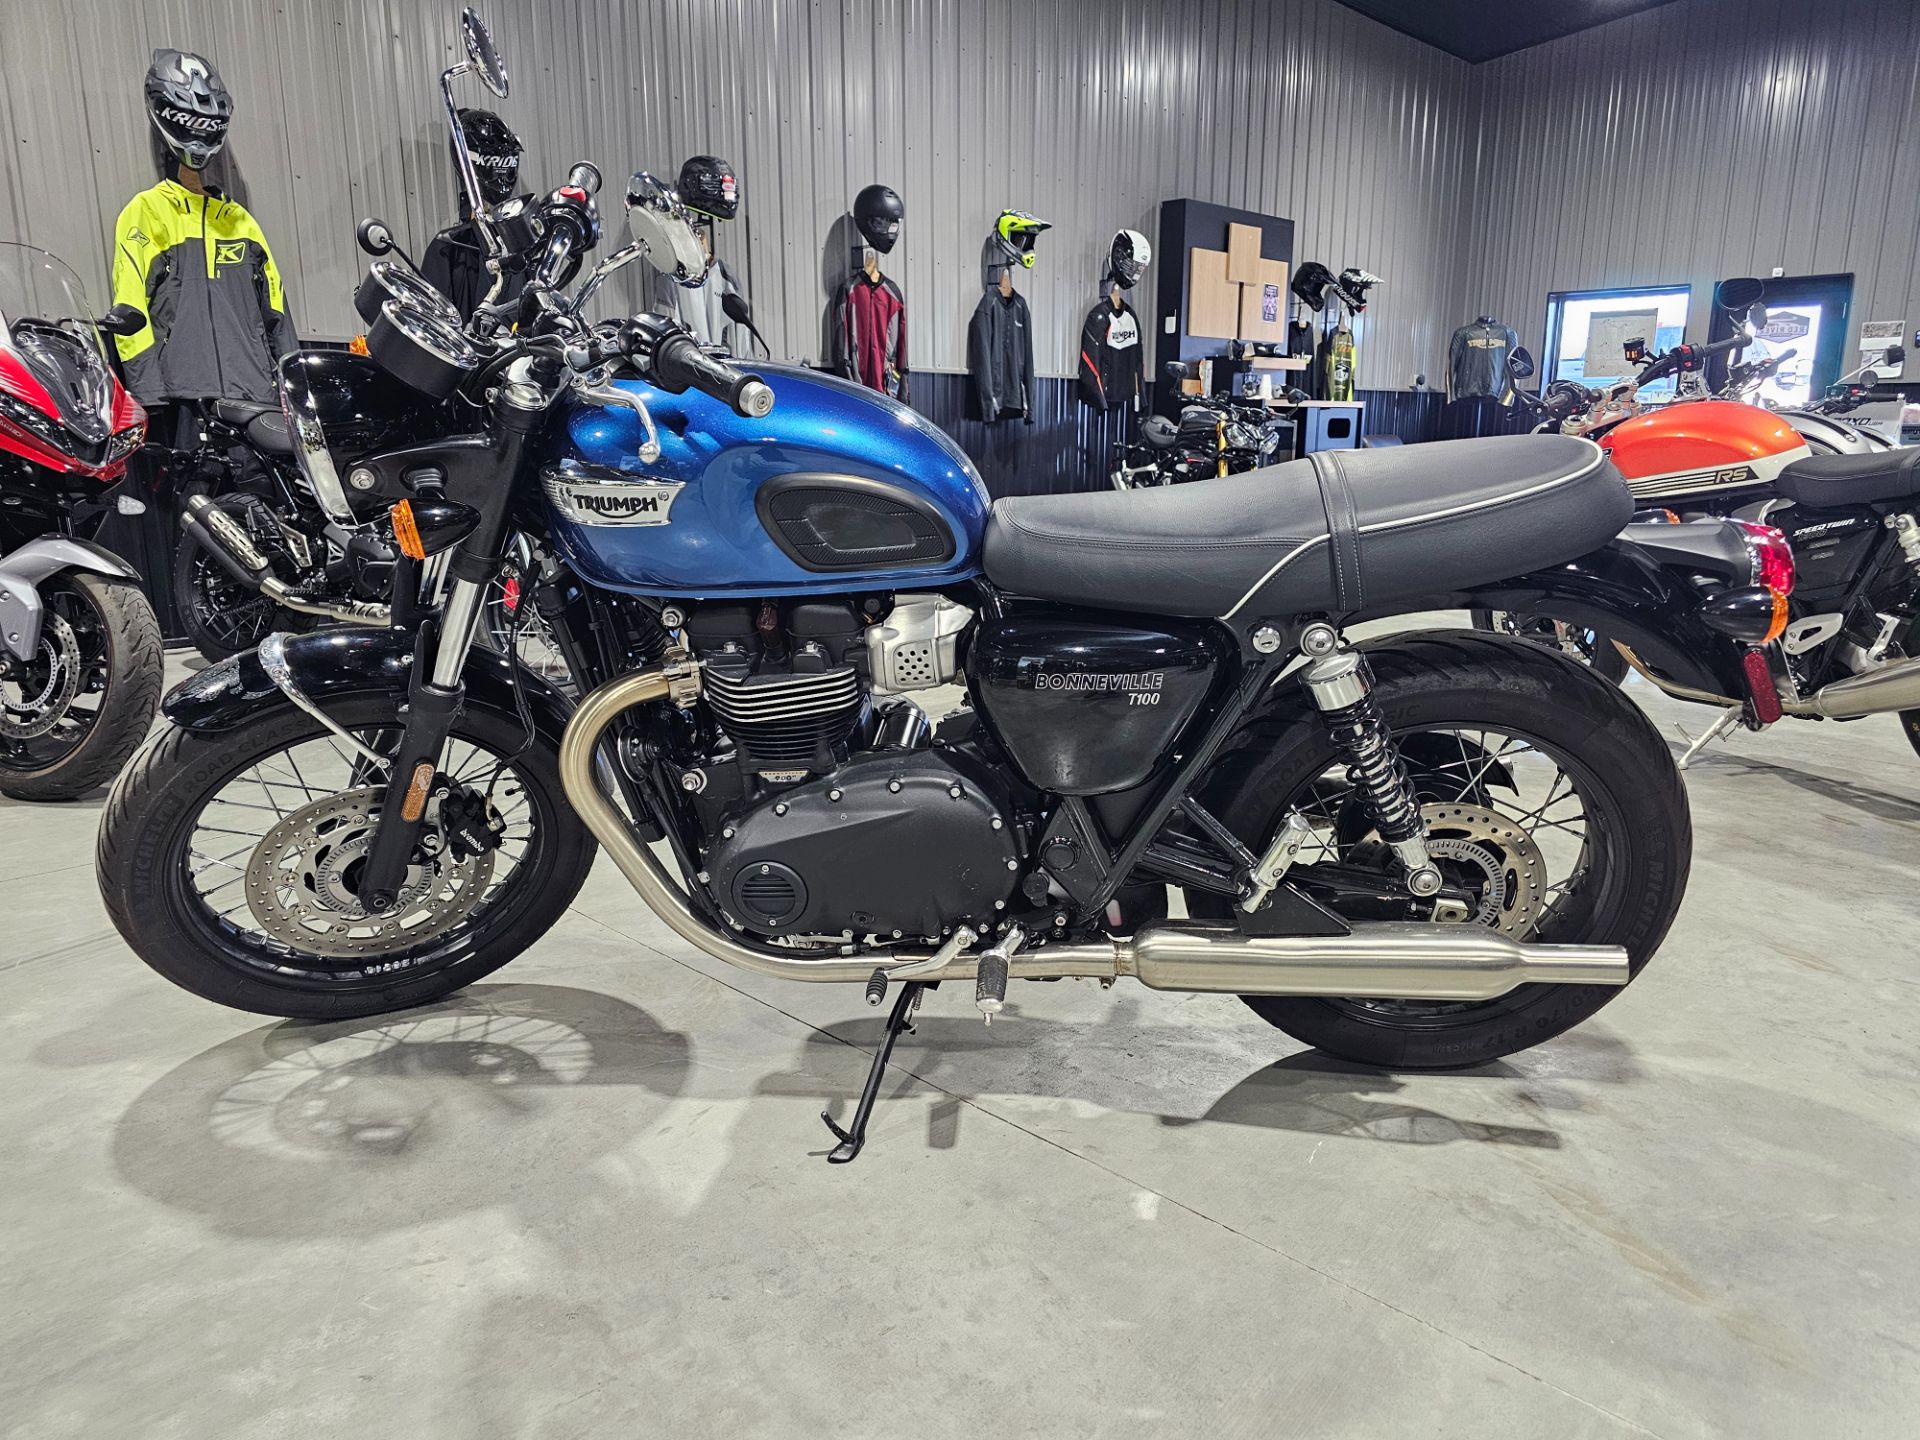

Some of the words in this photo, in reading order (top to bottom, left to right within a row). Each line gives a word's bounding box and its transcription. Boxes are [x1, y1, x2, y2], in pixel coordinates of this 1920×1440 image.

[161, 107, 222, 132] KRIOS
[1715, 467, 1749, 484] RS
[573, 493, 659, 517] TRIUMPH
[1792, 523, 1827, 537] SPEED
[1826, 518, 1856, 529] TWIN
[1035, 673, 1164, 690] BONNEVILLE
[1128, 692, 1161, 706] T100
[183, 752, 235, 794] ROAD
[460, 828, 485, 852] brembo
